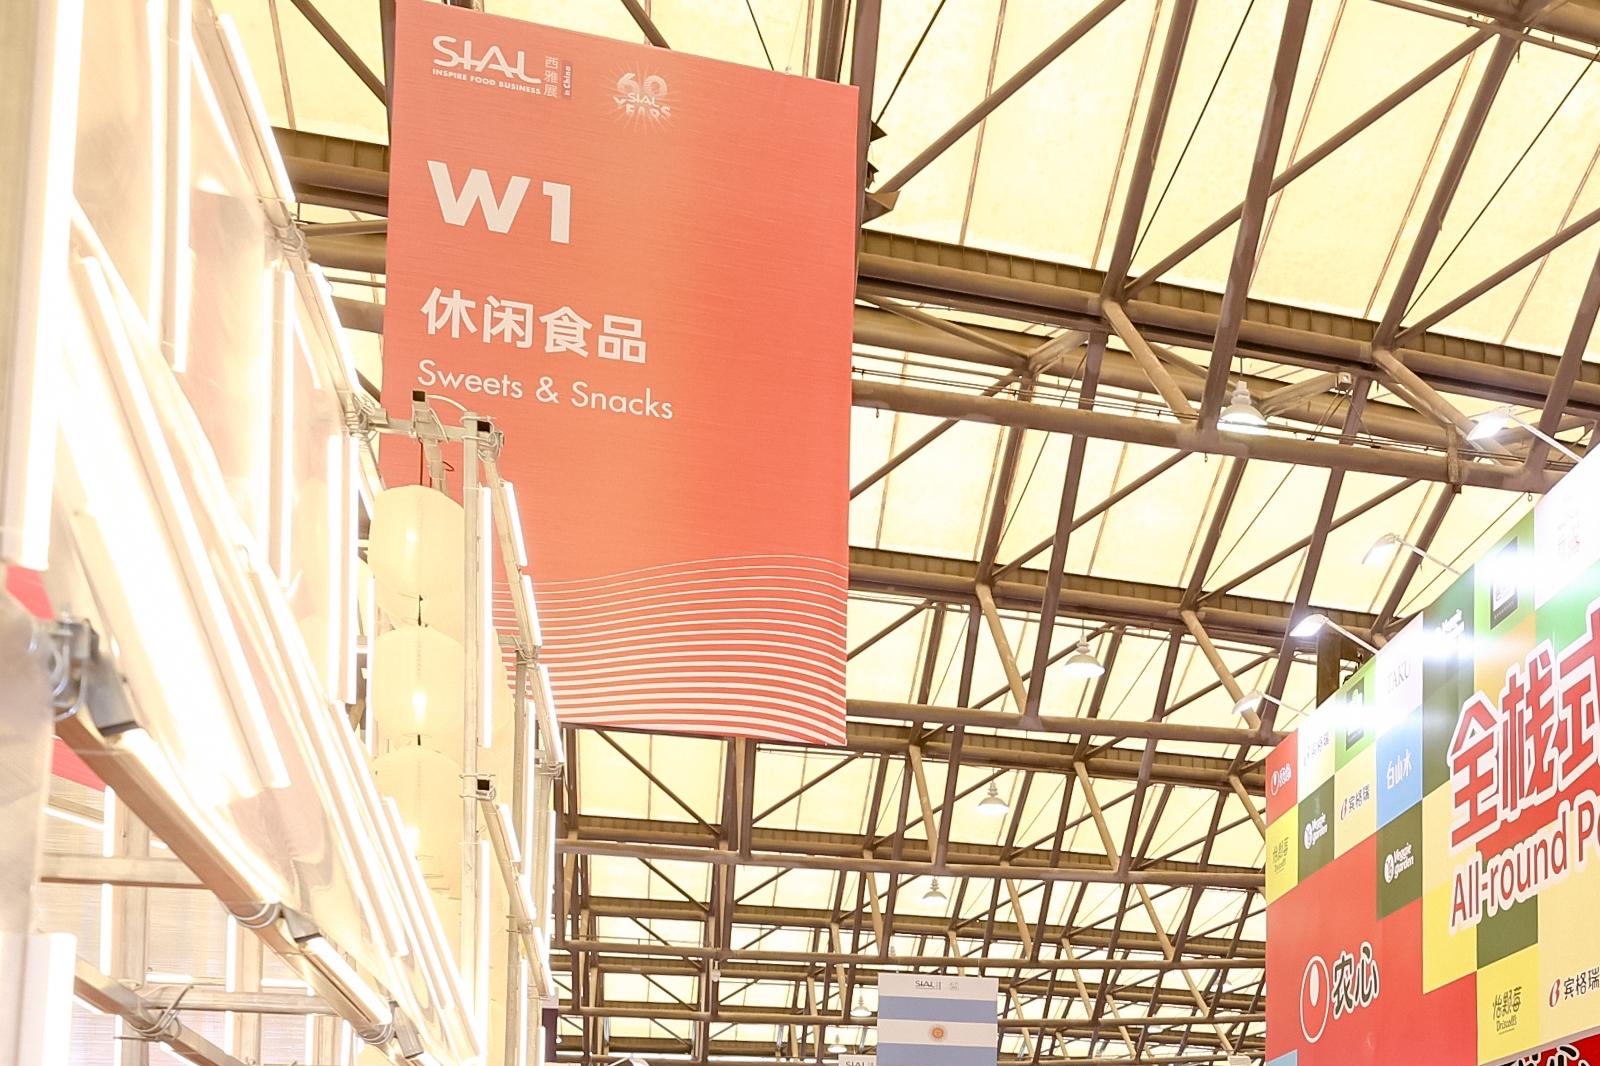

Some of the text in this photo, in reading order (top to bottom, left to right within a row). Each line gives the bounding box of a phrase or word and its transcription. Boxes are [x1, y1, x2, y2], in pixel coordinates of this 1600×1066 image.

[432, 35, 541, 84] SIAL
[432, 68, 541, 95] INSPIRE FOOD BUSINESS
[543, 56, 559, 98] 西雅展
[615, 72, 668, 98] 60
[427, 160, 571, 244] W1
[421, 287, 647, 364] 休闲食品
[417, 359, 674, 420] Sweets & Snacks
[1451, 829, 1568, 928] All-round
[1332, 944, 1379, 1016] 农心
[1564, 966, 1600, 1001] 宾格瑞
